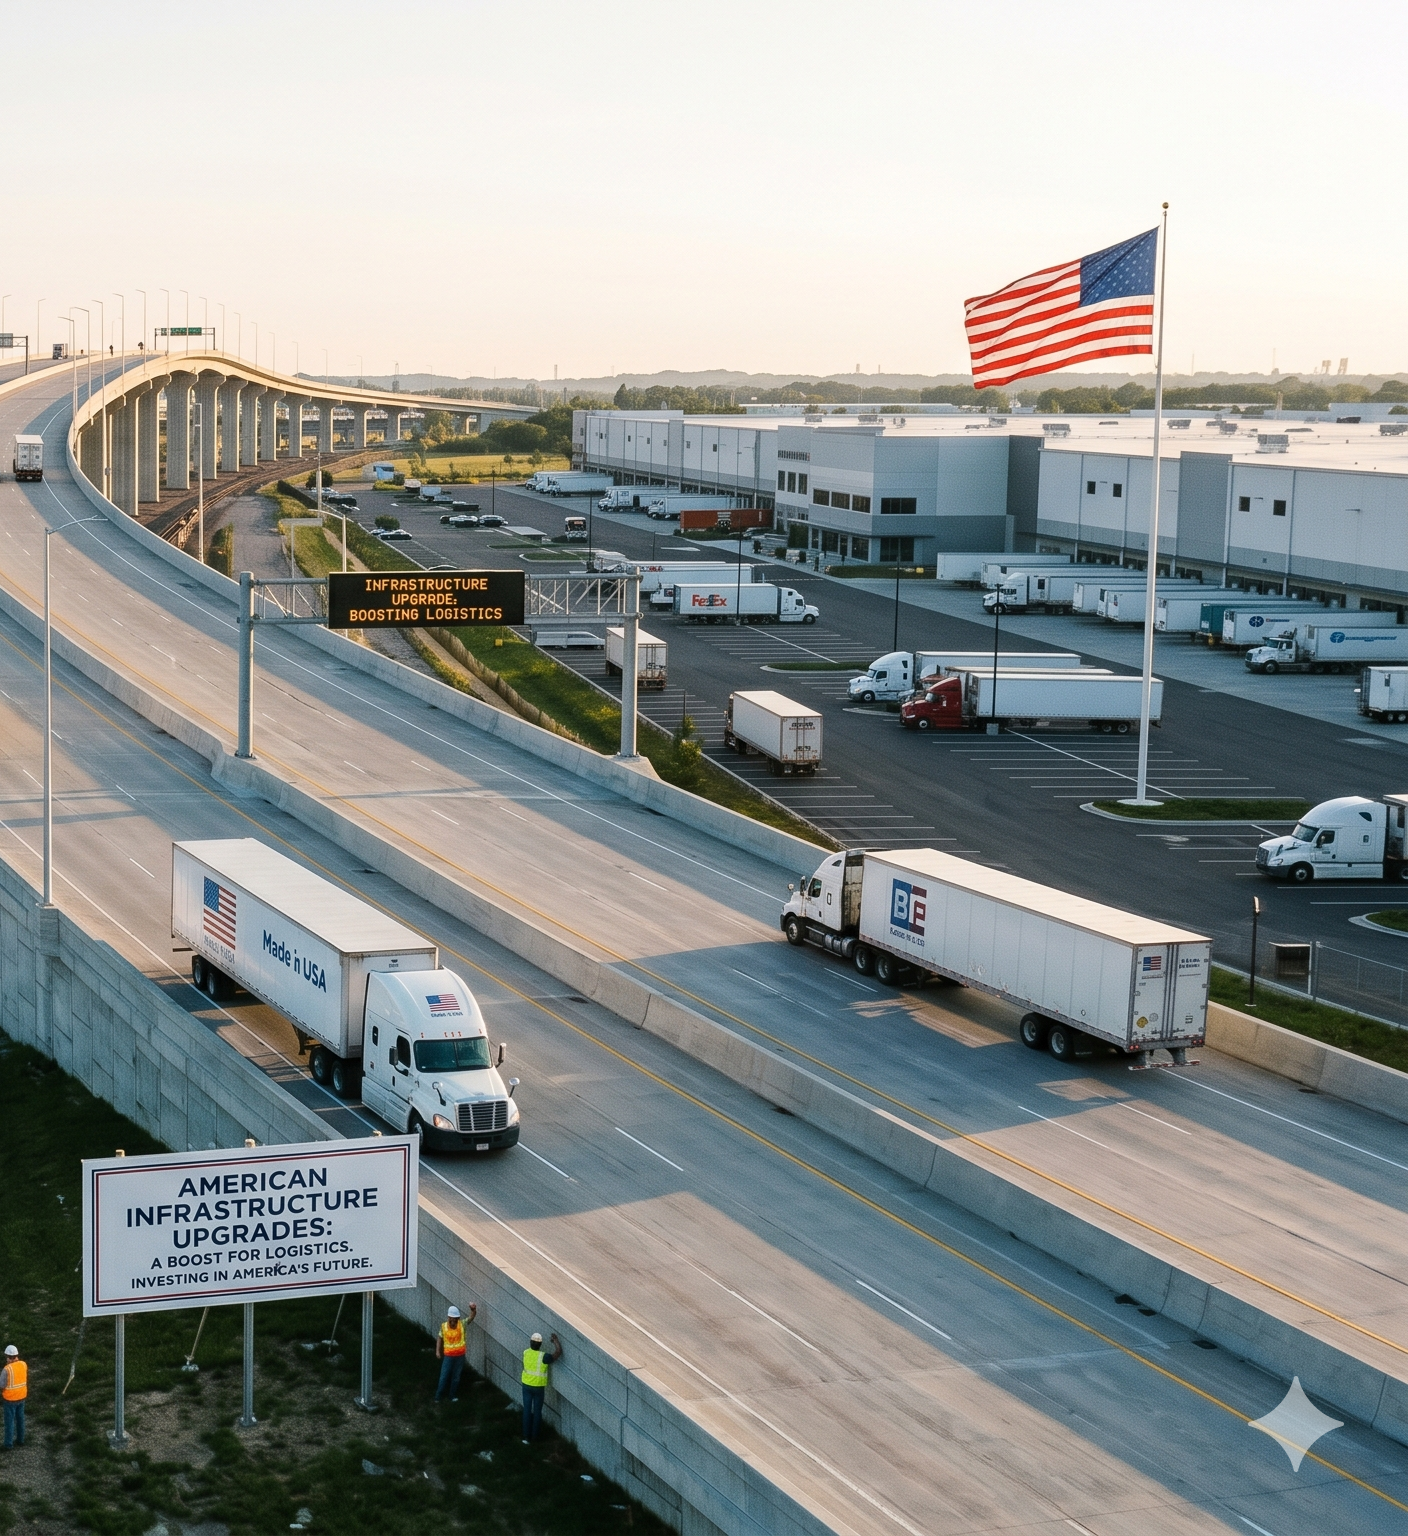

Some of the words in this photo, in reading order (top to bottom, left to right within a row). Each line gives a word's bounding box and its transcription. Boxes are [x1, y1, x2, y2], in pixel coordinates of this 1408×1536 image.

[365, 578, 488, 591] INFRASTRUCTURE
[349, 609, 419, 621] BOOSTING
[426, 608, 503, 620] LOGISTICS
[263, 929, 291, 967] Made
[303, 957, 327, 993] USA
[177, 1167, 327, 1198] AMERICAN
[126, 1187, 378, 1228] INFRASTRUCTURE
[173, 1217, 333, 1249] UPGRADES:
[150, 1257, 163, 1270] A
[167, 1252, 223, 1268] BOOST
[228, 1249, 261, 1263] FOR
[266, 1240, 354, 1260] LOGISTICS.
[131, 1272, 210, 1289] INVESTING
[213, 1270, 229, 1282] IN
[313, 1257, 373, 1273] FUTURE.
